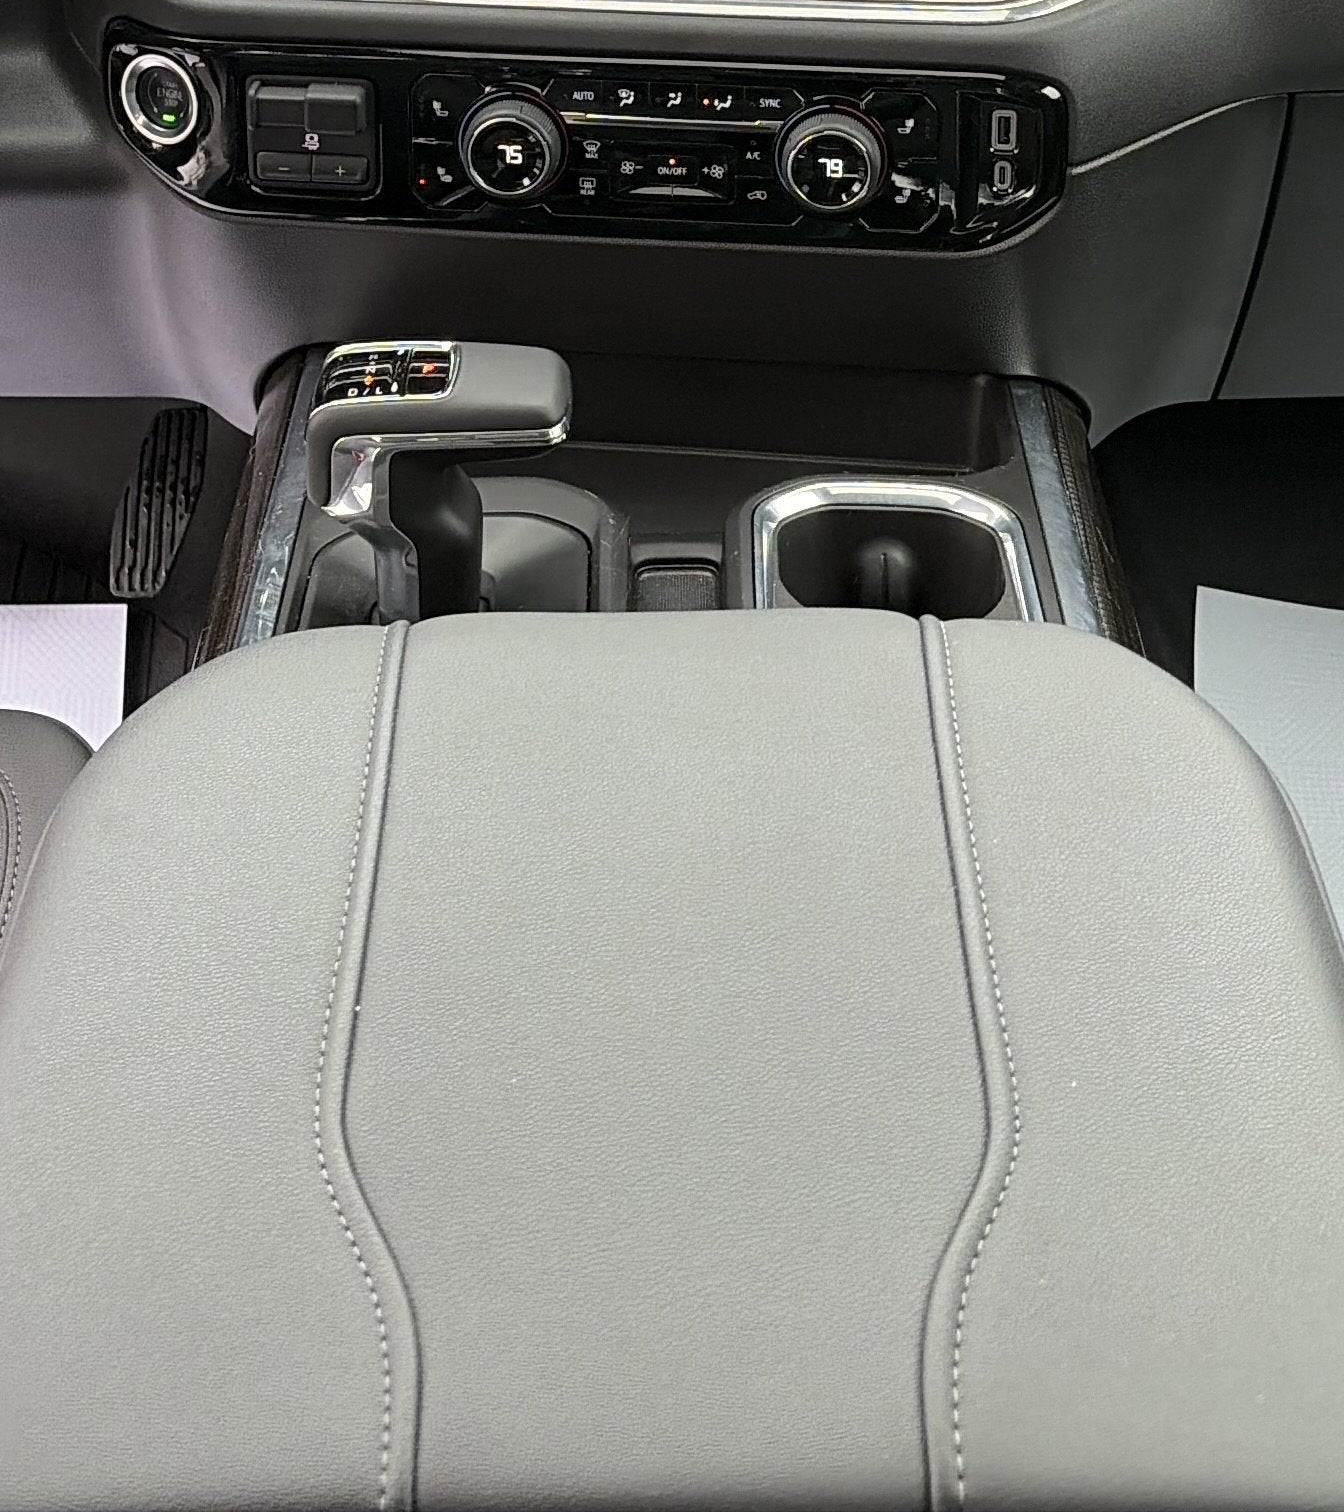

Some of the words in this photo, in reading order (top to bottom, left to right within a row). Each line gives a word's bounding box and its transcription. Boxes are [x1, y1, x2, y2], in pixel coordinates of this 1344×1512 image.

[572, 90, 595, 101] AUTO
[759, 98, 781, 109] SYNC
[497, 144, 523, 165] 75
[745, 151, 761, 161] A/C
[657, 166, 687, 176] ON/OFF
[817, 158, 844, 178] 79
